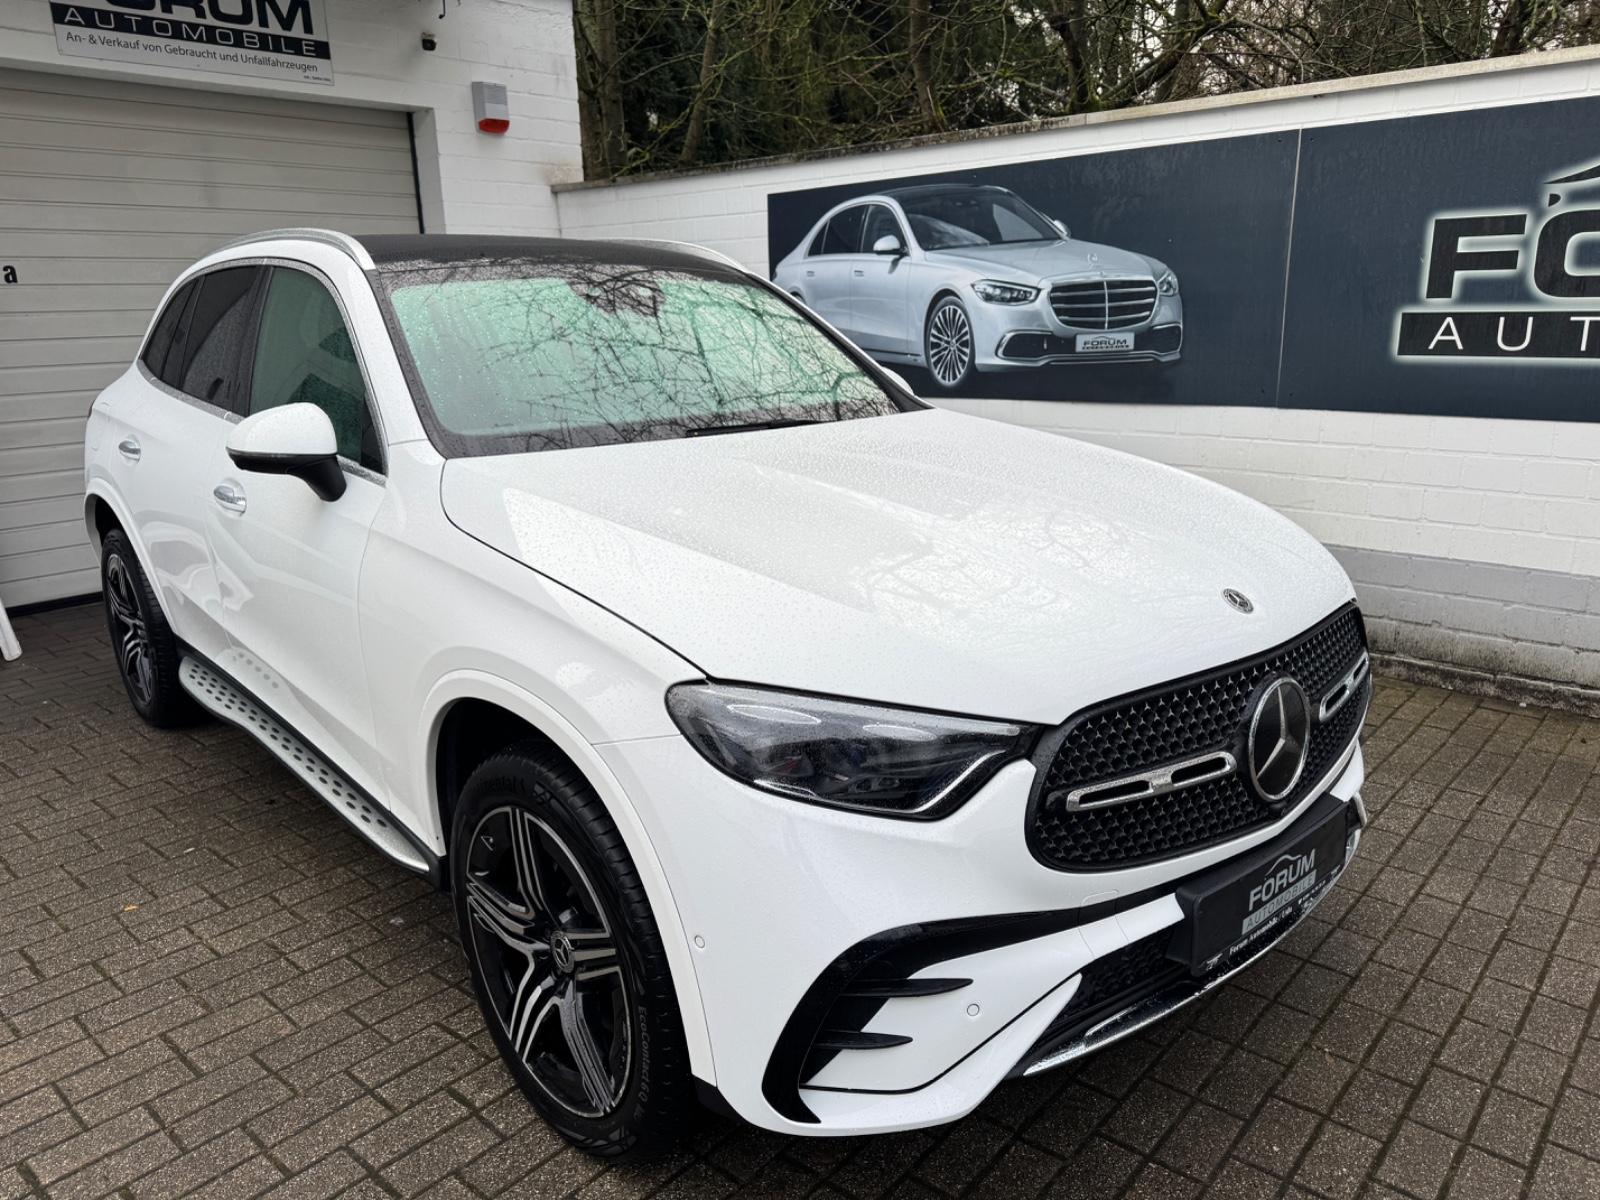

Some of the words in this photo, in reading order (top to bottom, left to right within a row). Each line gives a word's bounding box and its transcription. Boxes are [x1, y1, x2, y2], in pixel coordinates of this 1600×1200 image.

[64, 7, 316, 57] AUTOMOBILE
[66, 31, 86, 43] An-
[88, 33, 97, 45] &
[98, 35, 140, 50] Verkauf
[142, 43, 162, 53] von
[164, 44, 217, 60] Gebraucht
[219, 52, 239, 62] und
[240, 54, 318, 73] Unfallfahrzeugen
[2, 265, 18, 284] a
[1249, 848, 1316, 912] FORUM
